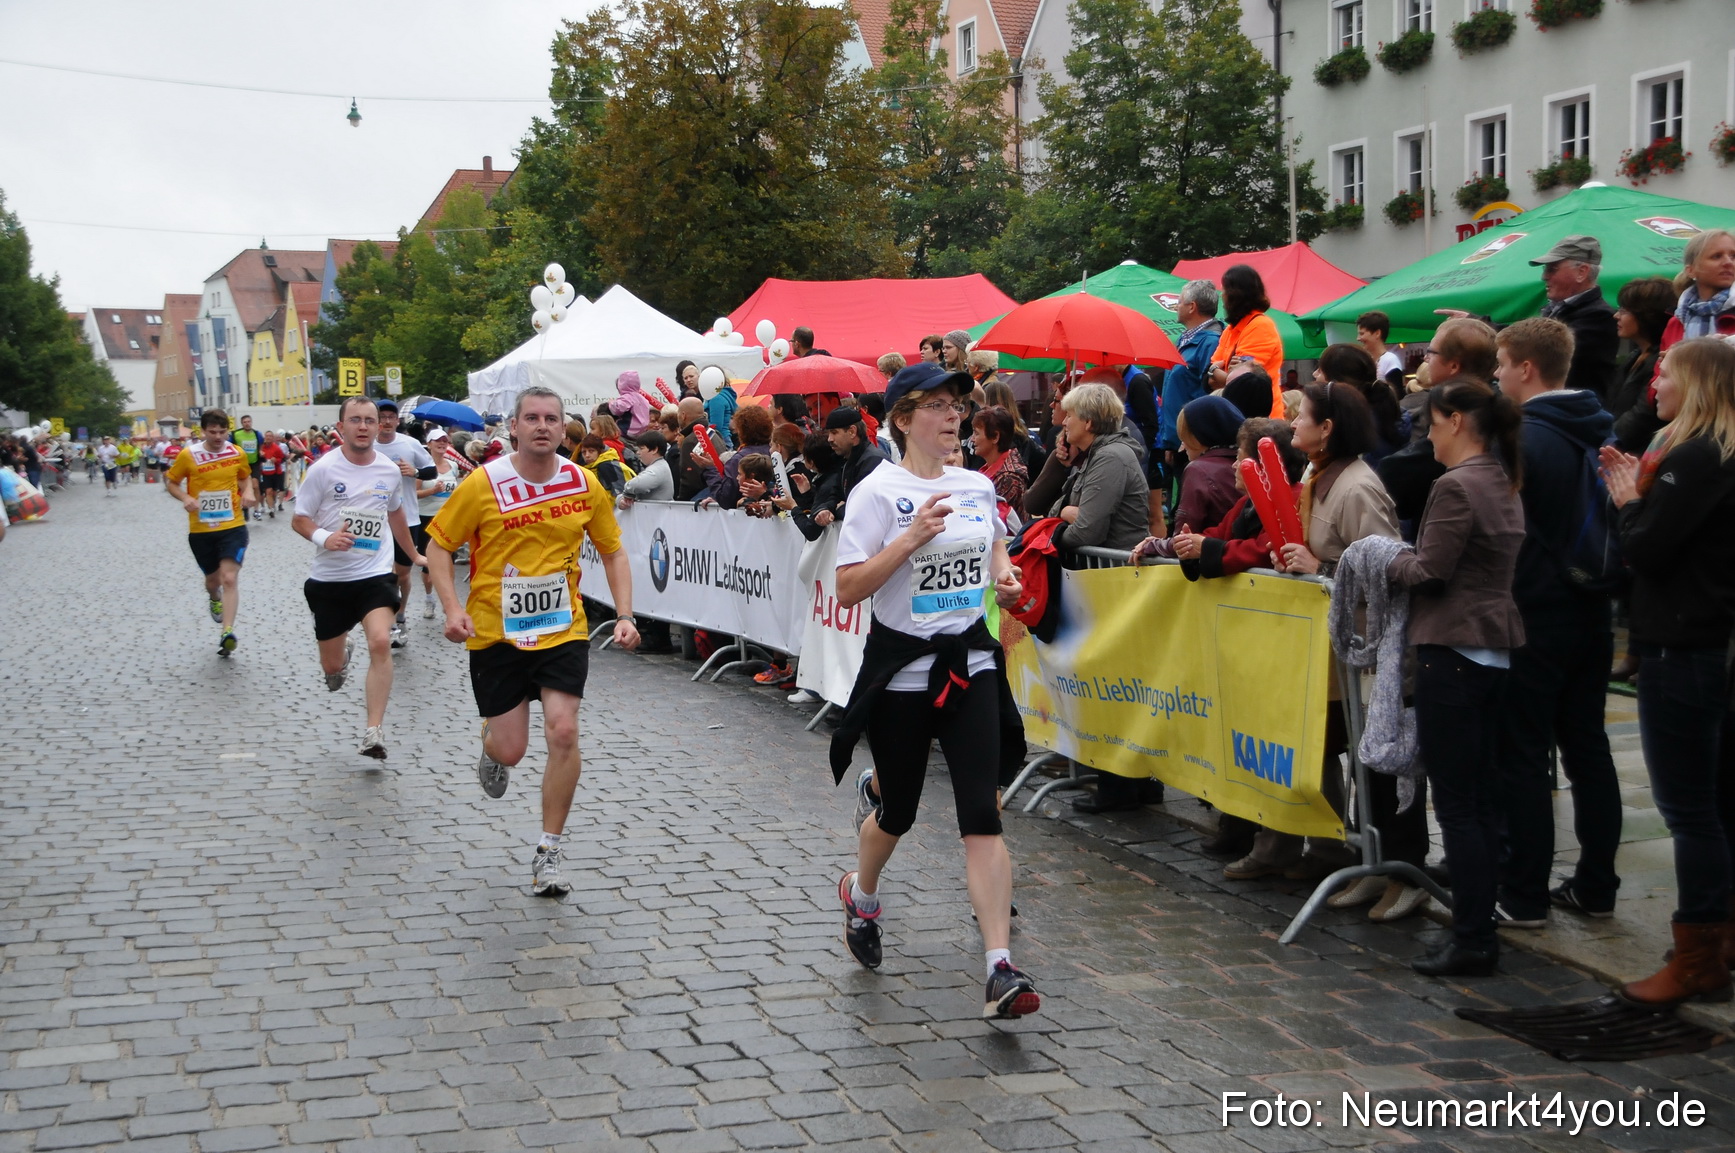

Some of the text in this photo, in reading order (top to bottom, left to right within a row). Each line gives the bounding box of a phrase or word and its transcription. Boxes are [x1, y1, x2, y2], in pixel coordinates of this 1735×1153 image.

[342, 360, 362, 368] Block
[346, 370, 358, 387] B
[201, 498, 230, 511] 2976
[502, 500, 592, 531] MAX BÖGL
[343, 517, 382, 538] 2392
[915, 547, 977, 564] PARTL Neumarkt
[674, 546, 773, 605] BMW Laufsport
[919, 557, 982, 591] 2535
[527, 580, 558, 589] Neumarkt
[509, 587, 563, 615] 3007
[936, 596, 970, 609] Ulrike
[518, 616, 558, 629] Christian
[1231, 729, 1294, 789] KANN
